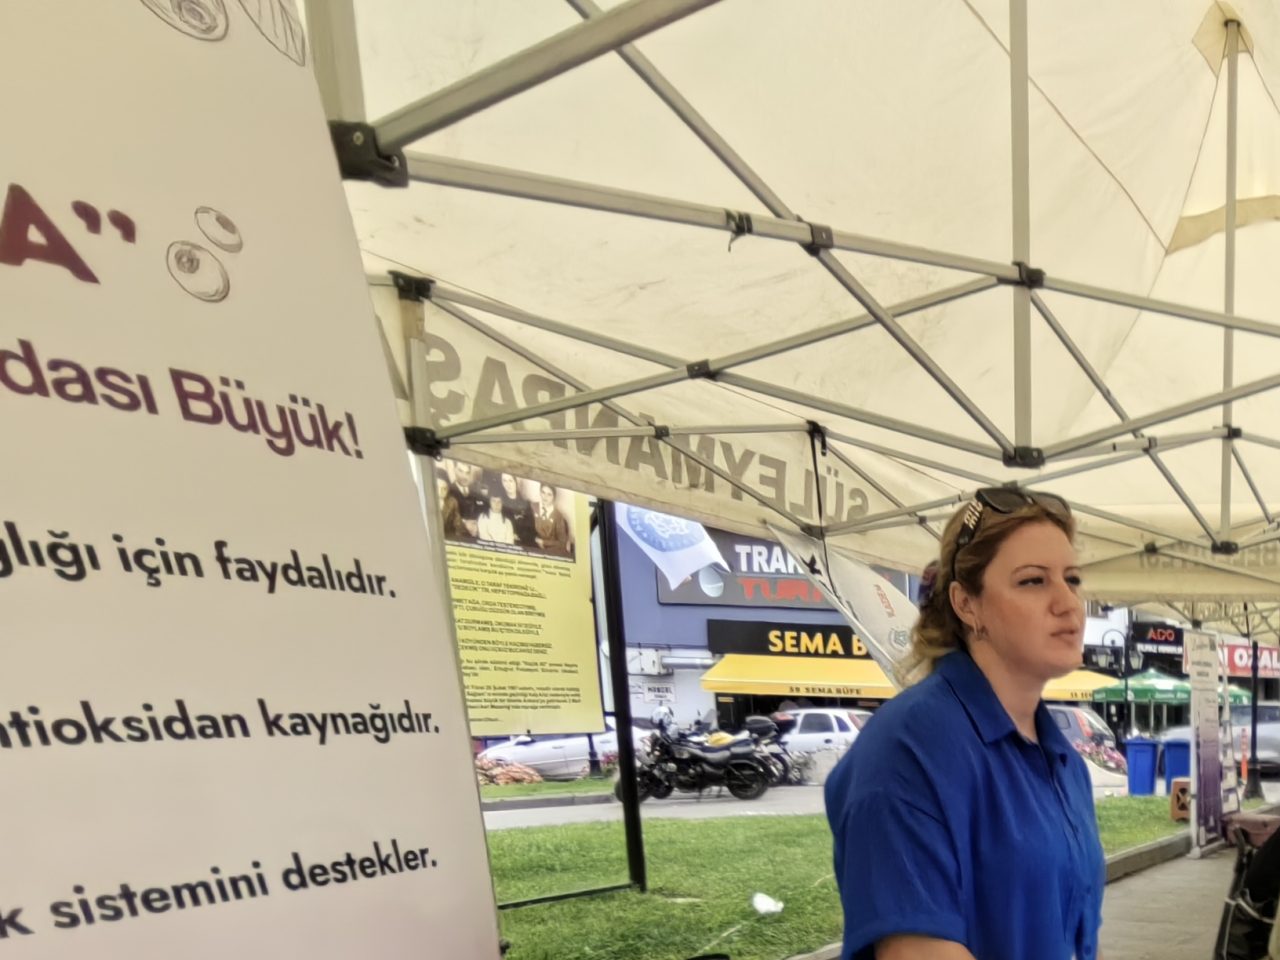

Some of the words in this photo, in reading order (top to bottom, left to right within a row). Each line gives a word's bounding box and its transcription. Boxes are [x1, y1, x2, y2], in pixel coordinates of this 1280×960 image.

[168, 367, 363, 459] Büyük!
[112, 533, 204, 588] için
[214, 540, 396, 598] faydalıdır.
[768, 629, 844, 656] SEMA
[257, 698, 440, 746] kaynağıdır.
[50, 861, 269, 930] sistemini
[282, 839, 438, 891] destekler.
